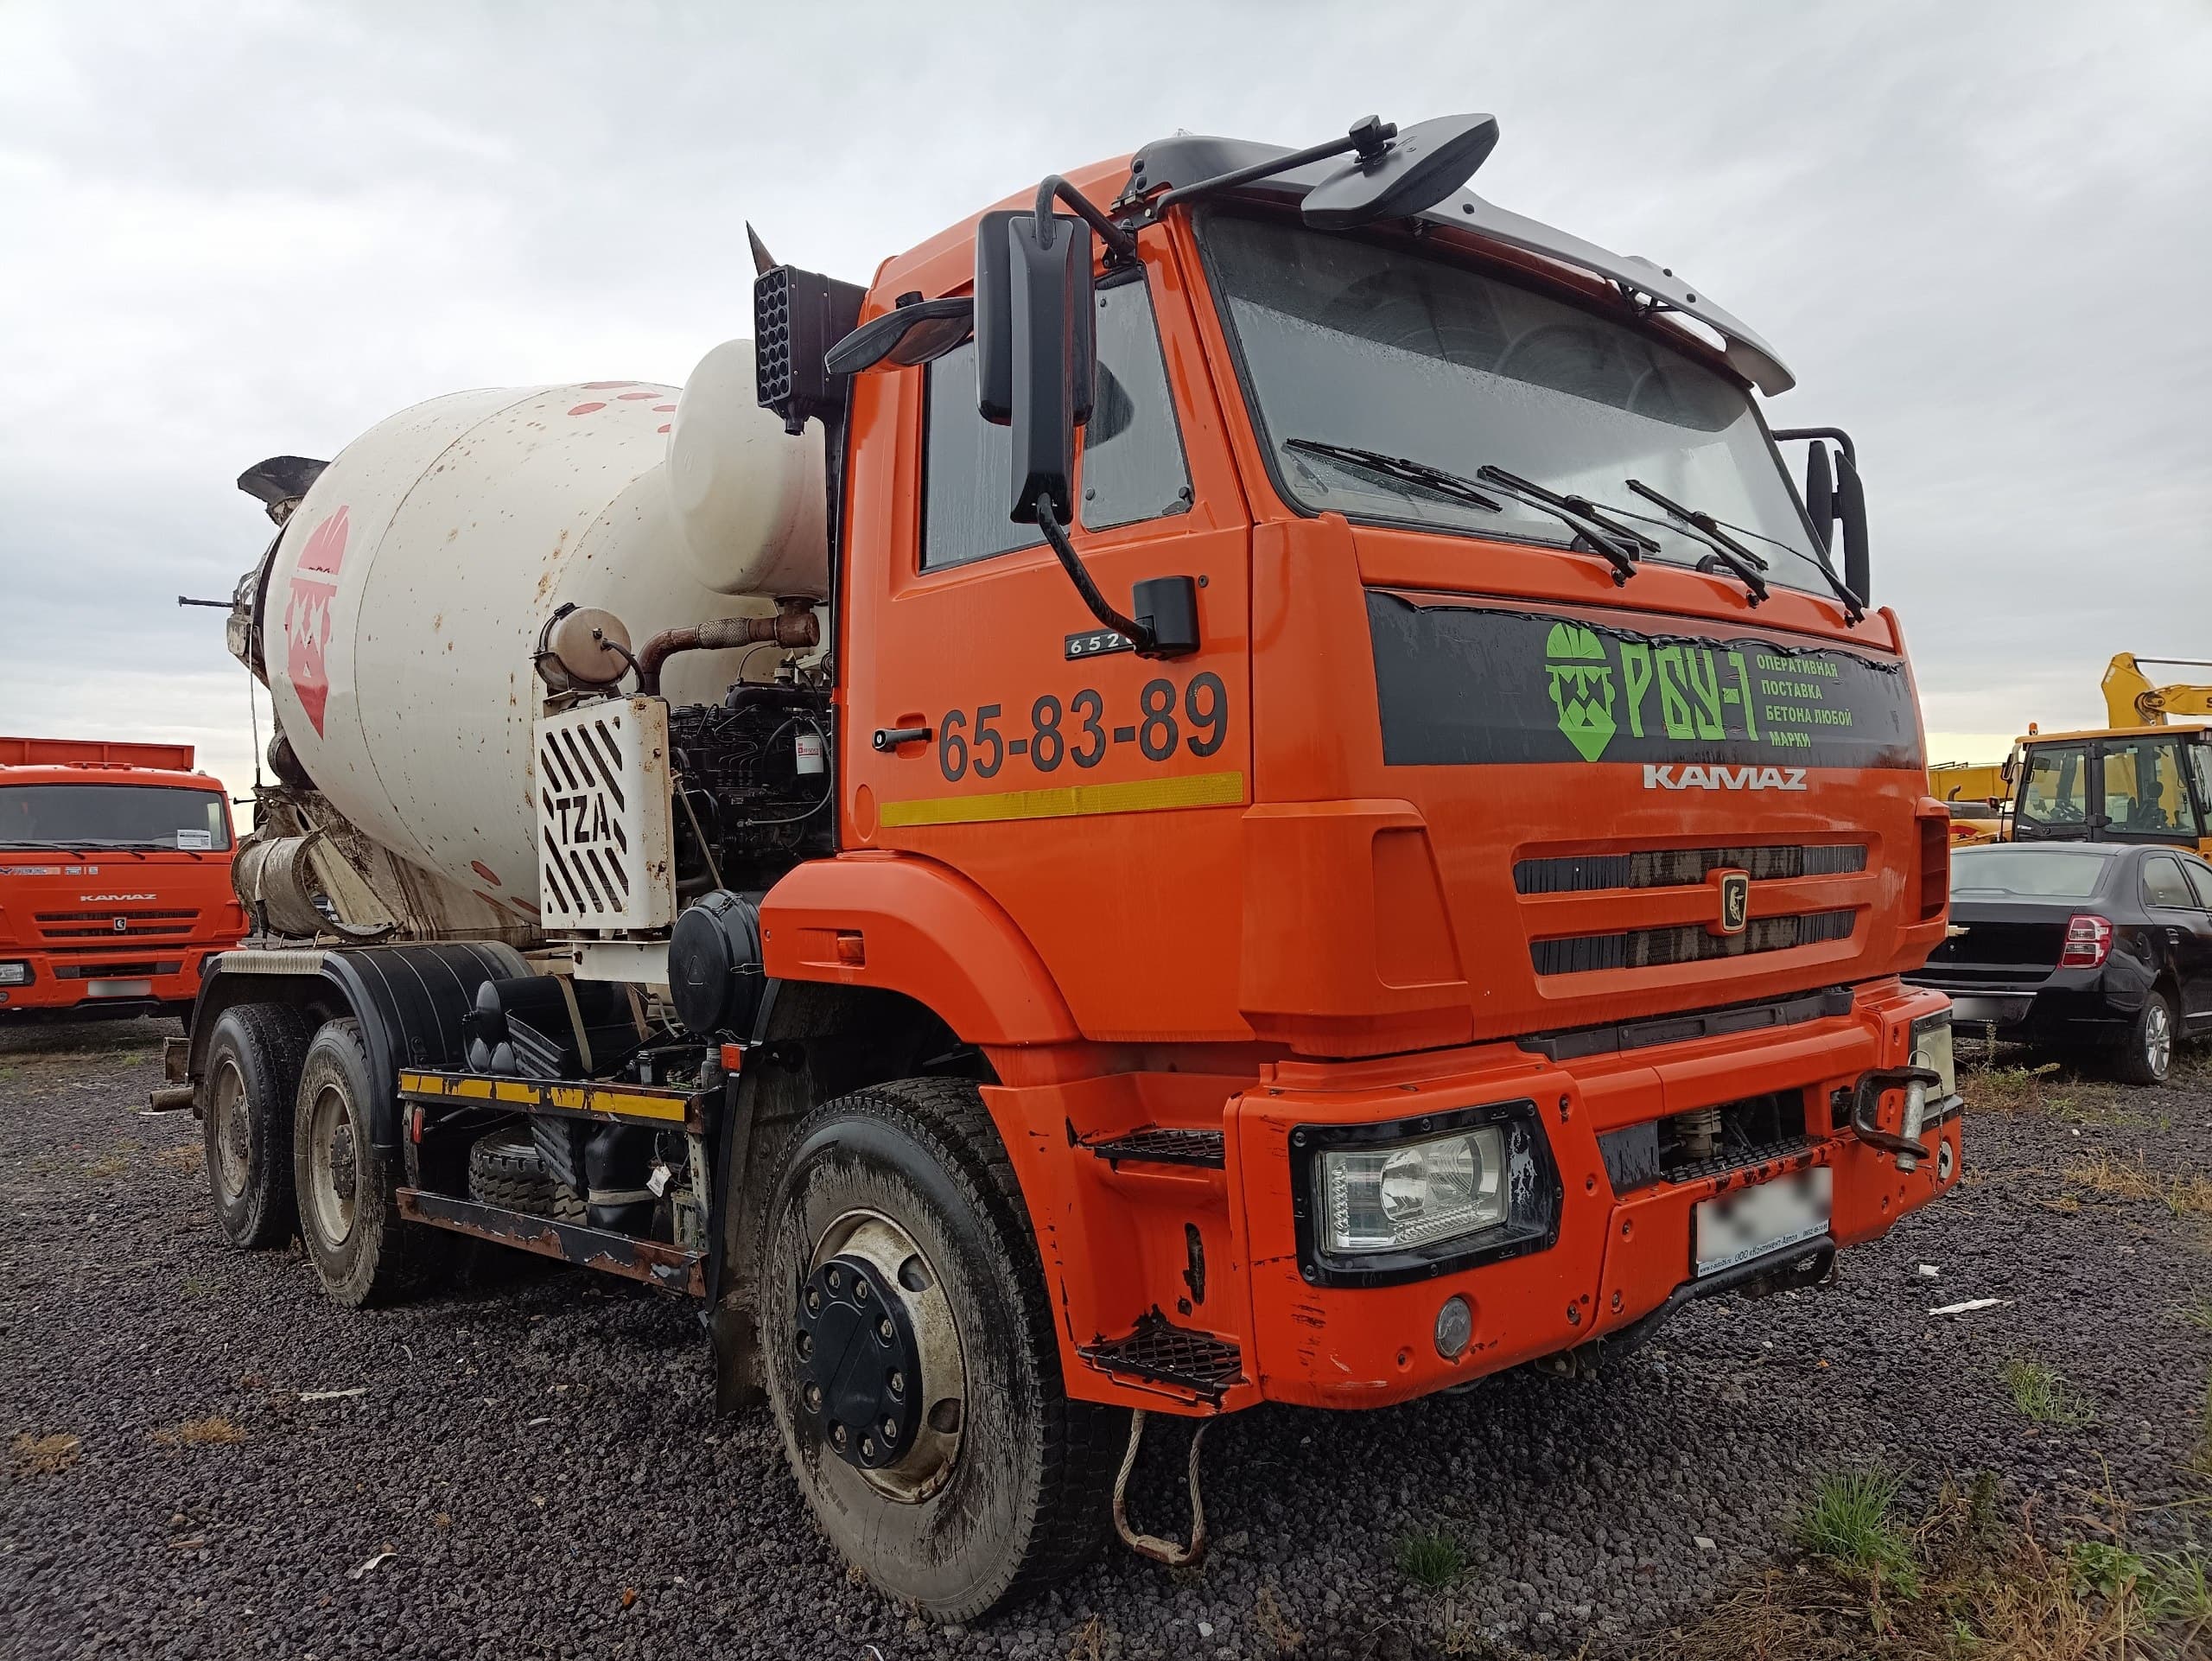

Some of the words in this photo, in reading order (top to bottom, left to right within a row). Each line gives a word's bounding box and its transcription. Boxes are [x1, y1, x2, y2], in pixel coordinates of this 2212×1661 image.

[1071, 633, 1133, 654] 652
[1756, 654, 1839, 678] ОПЕРАТИВНАЯ
[1619, 642, 1760, 741] РБУ-1
[1761, 679, 1823, 700] ПОСТАВКА
[938, 671, 1229, 782] 65-83-89
[1765, 704, 1813, 723] БЕТОНА
[1814, 709, 1853, 727] ЛЮБОЙ
[1769, 731, 1811, 748] МАРКИ
[1643, 764, 1808, 791] KAMAZ
[556, 792, 612, 845] TZA
[1734, 1250, 1748, 1262] ООО
